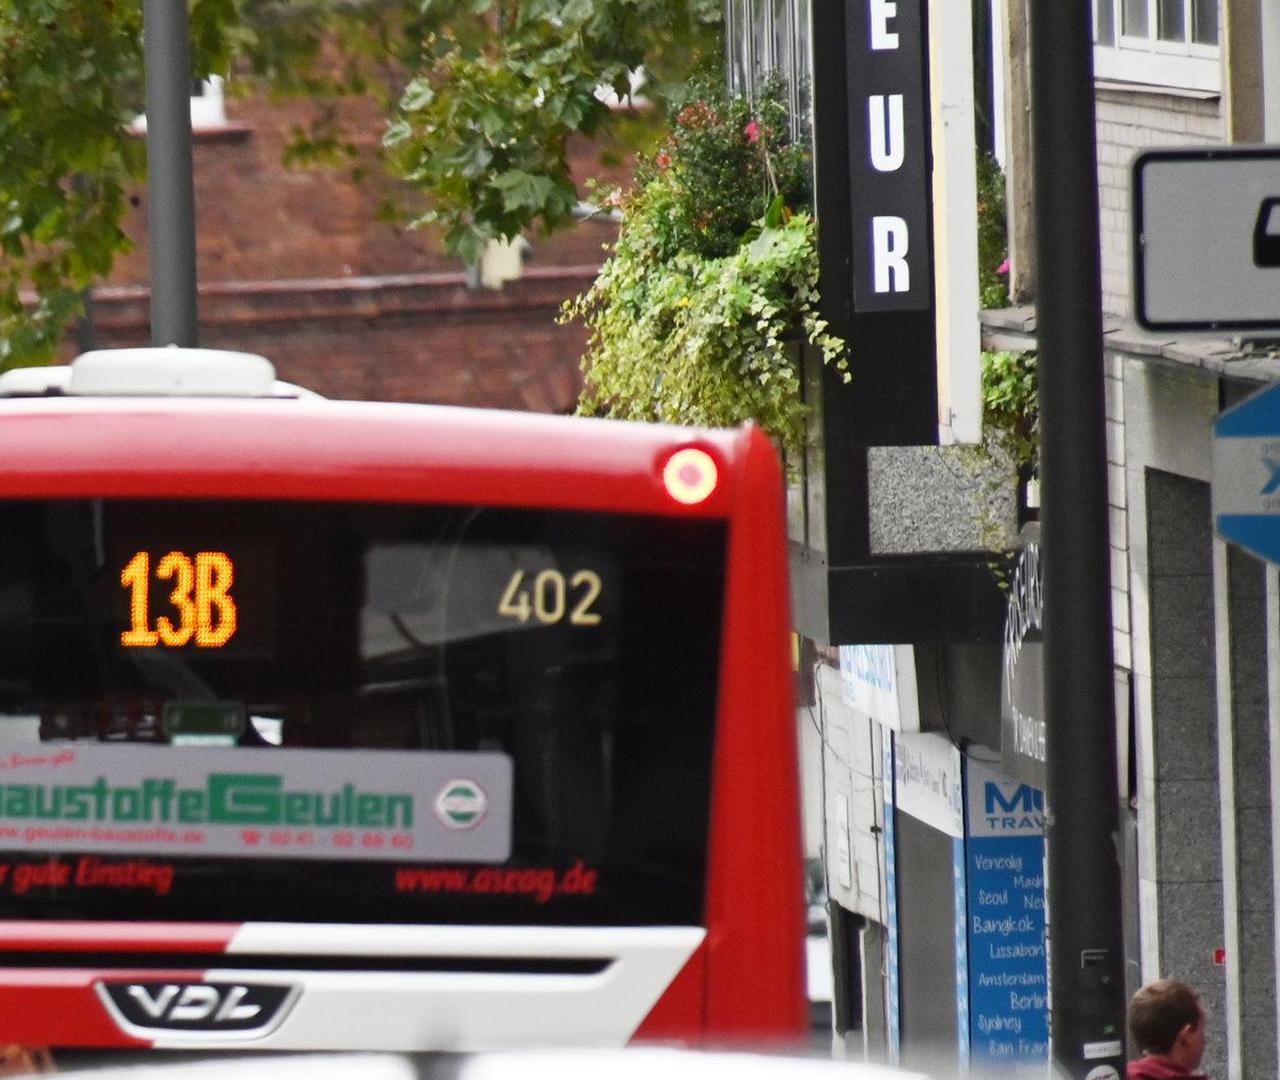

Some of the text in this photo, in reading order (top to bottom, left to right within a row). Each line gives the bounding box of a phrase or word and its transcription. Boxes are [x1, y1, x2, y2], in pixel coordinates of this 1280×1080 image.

[120, 551, 237, 648] 13B
[498, 569, 603, 626] 402
[12, 859, 72, 895] gute
[75, 855, 175, 896] Einstieg
[395, 858, 598, 903] www.aseag.de
[978, 888, 1009, 905] Seoul
[973, 915, 1036, 936] Bangkok
[989, 943, 1045, 960] Lissabon
[978, 971, 1045, 987] Amsterdam
[127, 984, 262, 1022] VDL
[978, 1013, 1022, 1034] Sydney
